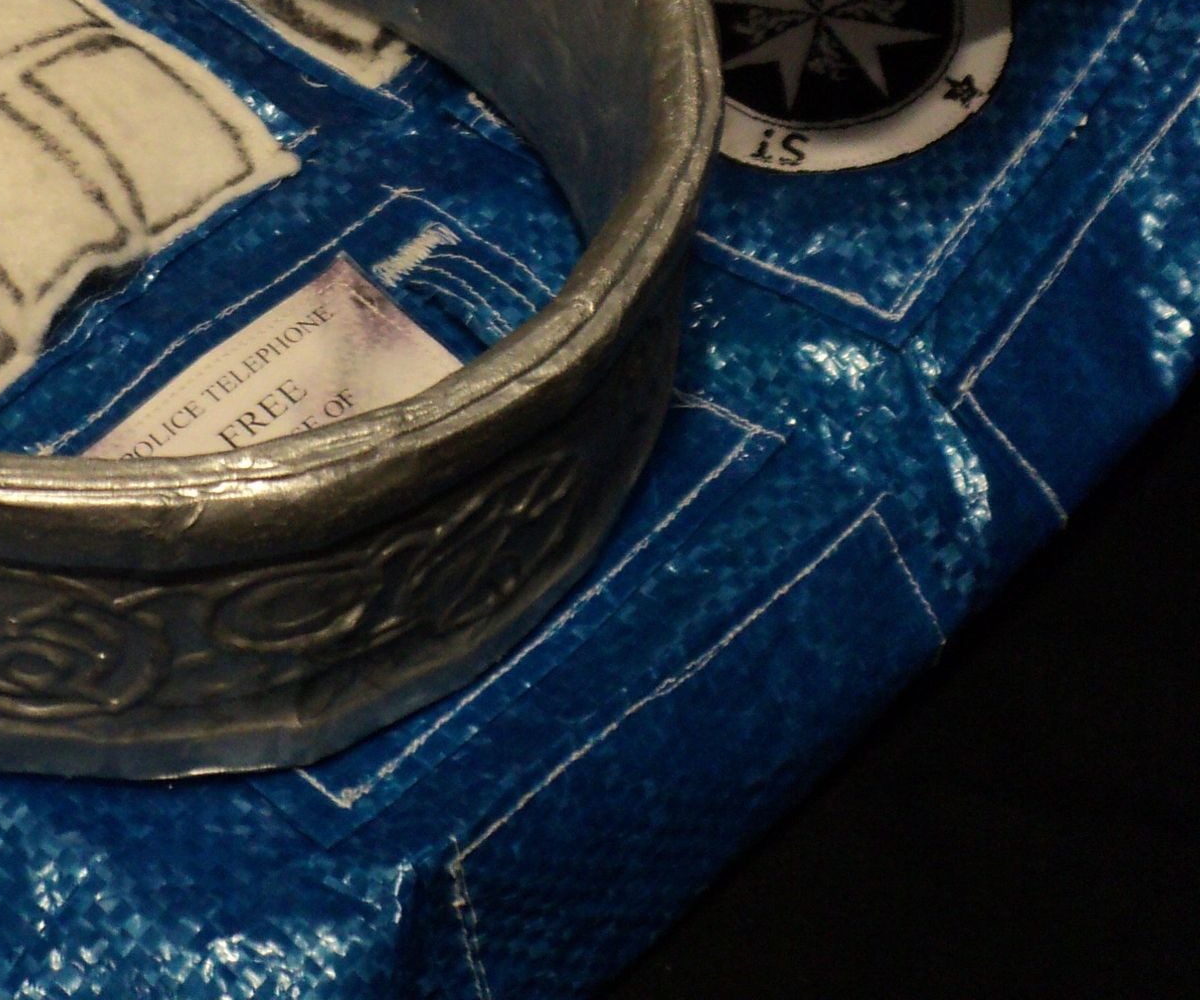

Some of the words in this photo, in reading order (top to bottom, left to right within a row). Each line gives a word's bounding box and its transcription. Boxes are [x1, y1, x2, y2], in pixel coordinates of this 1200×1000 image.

[201, 305, 335, 403] TELEPHONE
[217, 378, 308, 450] FREE
[323, 388, 354, 418] OF
